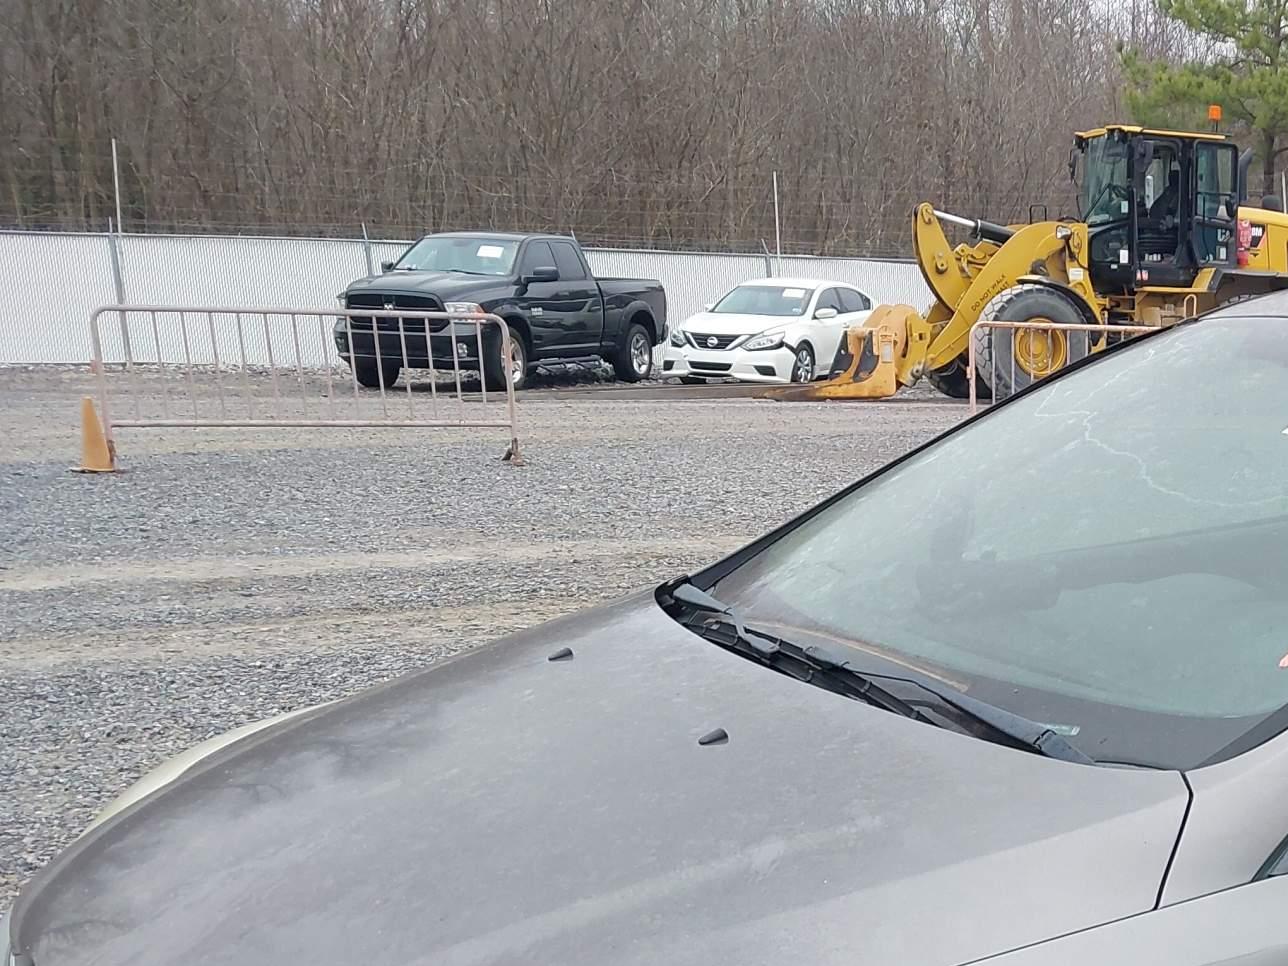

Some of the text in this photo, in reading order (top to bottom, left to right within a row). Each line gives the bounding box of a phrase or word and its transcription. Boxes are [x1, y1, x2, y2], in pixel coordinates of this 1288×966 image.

[971, 273, 1006, 311] DO NOT WALK
